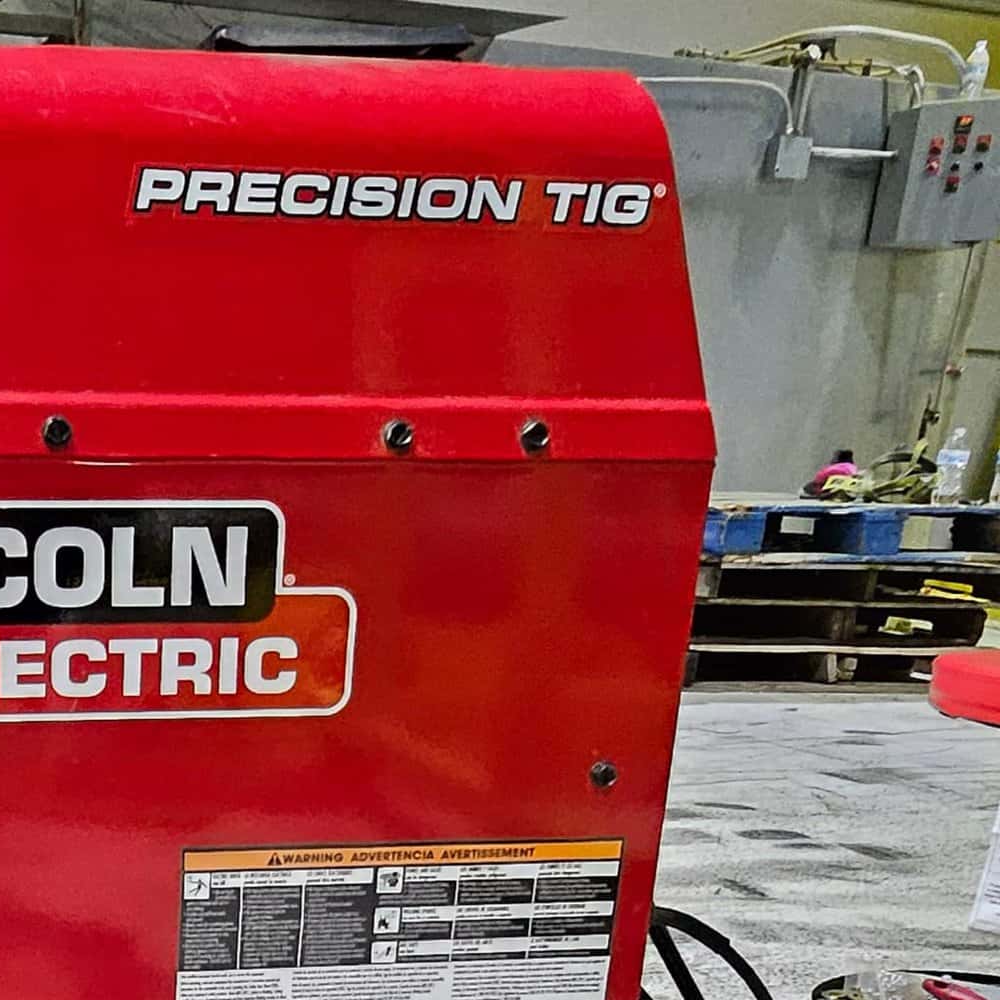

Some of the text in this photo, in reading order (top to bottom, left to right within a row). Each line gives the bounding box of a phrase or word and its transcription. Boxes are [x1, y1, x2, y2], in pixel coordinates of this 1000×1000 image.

[135, 167, 523, 222] PRECISION
[283, 847, 536, 864] WARNING ADVERTENCIA AVERTISSEMENT
